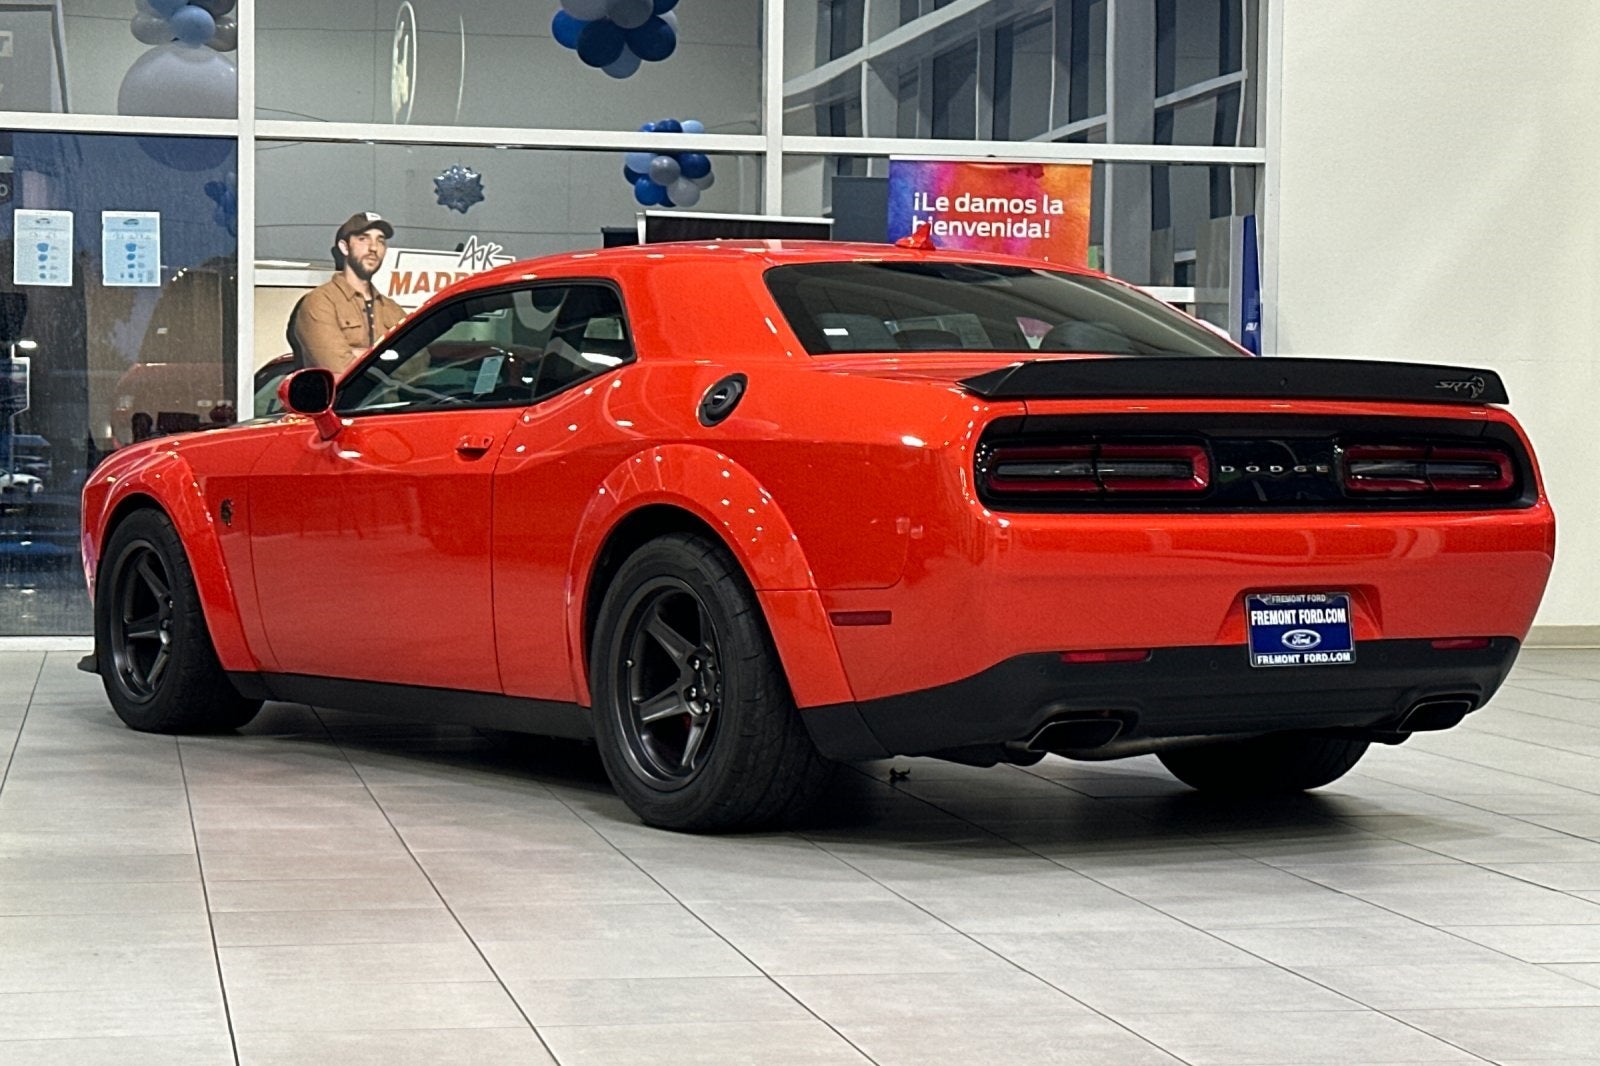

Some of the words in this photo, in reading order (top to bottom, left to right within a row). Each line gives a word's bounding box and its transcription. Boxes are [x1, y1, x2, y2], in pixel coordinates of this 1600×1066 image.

[954, 192, 1037, 215] damos
[1042, 194, 1064, 215] la
[1221, 465, 1328, 473] DODGE
[1272, 595, 1306, 603] FREMONT
[1307, 594, 1326, 602] FORD
[1251, 610, 1297, 626] FREMONT
[1298, 608, 1346, 625] FORD.COM
[1291, 633, 1312, 646] Ford
[1257, 654, 1300, 664] FREMONT
[1304, 652, 1351, 663] FORD.COM
